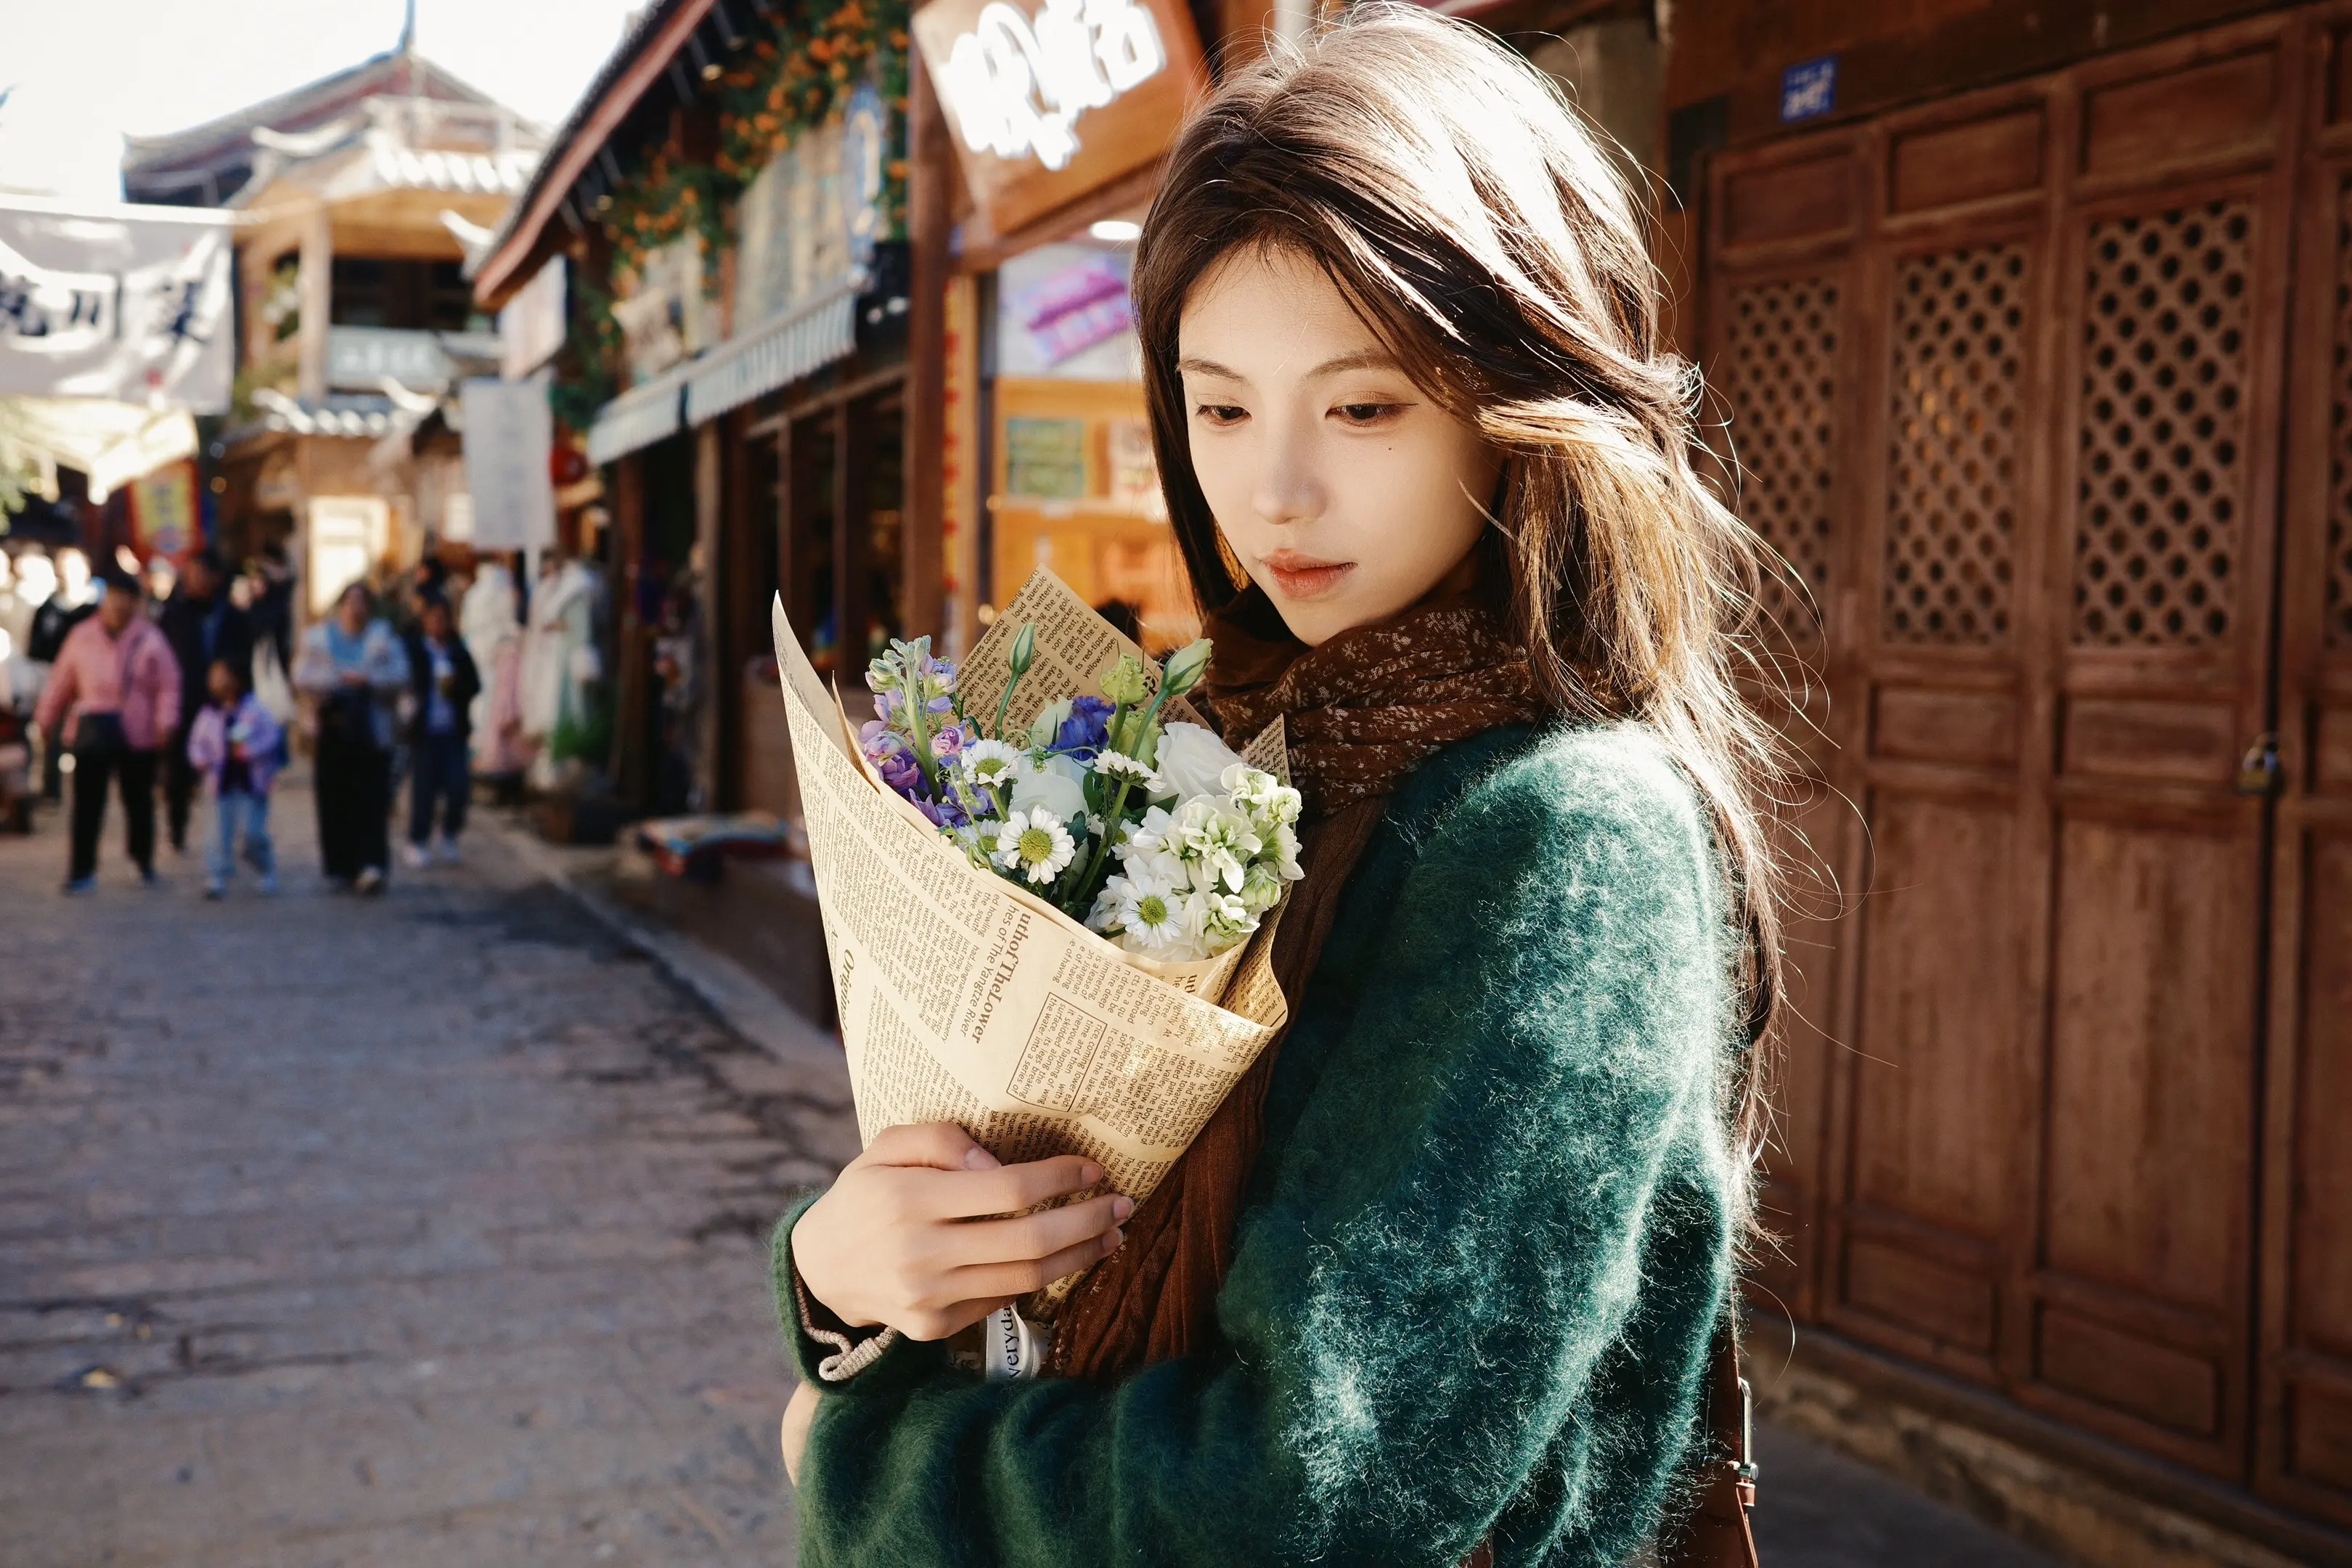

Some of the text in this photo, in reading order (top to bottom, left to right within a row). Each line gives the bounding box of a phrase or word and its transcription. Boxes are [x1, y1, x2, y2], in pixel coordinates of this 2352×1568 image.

[1011, 576, 1047, 618] loud querulo
[1045, 600, 1055, 611] the
[1021, 613, 1032, 624] the
[1037, 612, 1059, 638] and the
[1044, 605, 1077, 644] woodpecker,
[965, 645, 984, 667] scenes
[984, 618, 1005, 644] consists
[981, 639, 1001, 662] picture
[1000, 624, 1011, 637] whi
[1052, 619, 1079, 651] son crest,
[1060, 621, 1087, 658] gorget, and
[1066, 629, 1095, 665] ge; and the
[978, 657, 1000, 682] the eye.
[1074, 663, 1083, 671] its
[964, 701, 978, 714] was,
[977, 690, 985, 699] as
[987, 669, 1002, 685] have
[1006, 658, 1050, 709] rich and olden
[1020, 669, 1063, 724] with the idea of
[1025, 665, 1056, 703] we always
[1061, 678, 1071, 689] for
[974, 687, 1000, 719] autumnal
[986, 704, 1000, 720] clear
[1158, 701, 1168, 714] sun
[1159, 701, 1178, 725] light on
[916, 854, 930, 883] flowery.
[922, 852, 938, 891] the bright
[928, 871, 939, 897] conver
[934, 880, 945, 902] waves
[948, 899, 958, 913] The
[960, 899, 966, 909] of
[964, 889, 982, 928] Have had
[971, 892, 991, 933] the south
[936, 918, 945, 934] had
[978, 907, 996, 937] howling
[997, 928, 1007, 943] of
[924, 947, 936, 970] bridge,
[953, 934, 963, 955] ment
[987, 943, 1004, 963] The
[929, 929, 957, 1012] south of Yangtze River.
[957, 945, 979, 994] had, Jiangnan
[1062, 967, 1079, 989] having
[915, 973, 932, 1003] Jiangnan
[933, 938, 971, 1036] just now. The bridge instru
[935, 987, 949, 1016] become
[970, 967, 994, 1007] Yangtze
[1098, 973, 1119, 1008] fire deep
[1108, 976, 1129, 1013] dream be
[1047, 998, 1057, 1011] the
[1140, 995, 1157, 1017] being
[1147, 993, 1167, 1025] to often
[1161, 997, 1175, 1018] three
[960, 1008, 976, 1037] River
[1038, 1013, 1051, 1035] water
[1054, 1017, 1070, 1048] skidded
[1081, 1020, 1093, 1037] time
[1163, 1029, 1172, 1037] At
[1018, 1003, 1066, 1099] surface, its legs breaking
[1031, 1037, 1042, 1052] into
[1074, 1040, 1084, 1055] and
[1017, 1061, 1030, 1083] series
[1037, 1015, 1083, 1105] nervous flapping of wing
[1042, 1048, 1057, 1071] along
[1062, 1024, 1102, 1107] rice, coming lower each
[1065, 1056, 1077, 1074] then
[1085, 1037, 1114, 1092] circles the lake
[1012, 1085, 1018, 1095] of
[1035, 1070, 1046, 1084] the
[1055, 1084, 1065, 1098] with
[1151, 1055, 1187, 1126] udded path that led
[1164, 1060, 1196, 1118] went towards the
[1135, 1053, 1180, 1135] the valley. The boy was
[1159, 1063, 1205, 1143] side and reluctantly she
